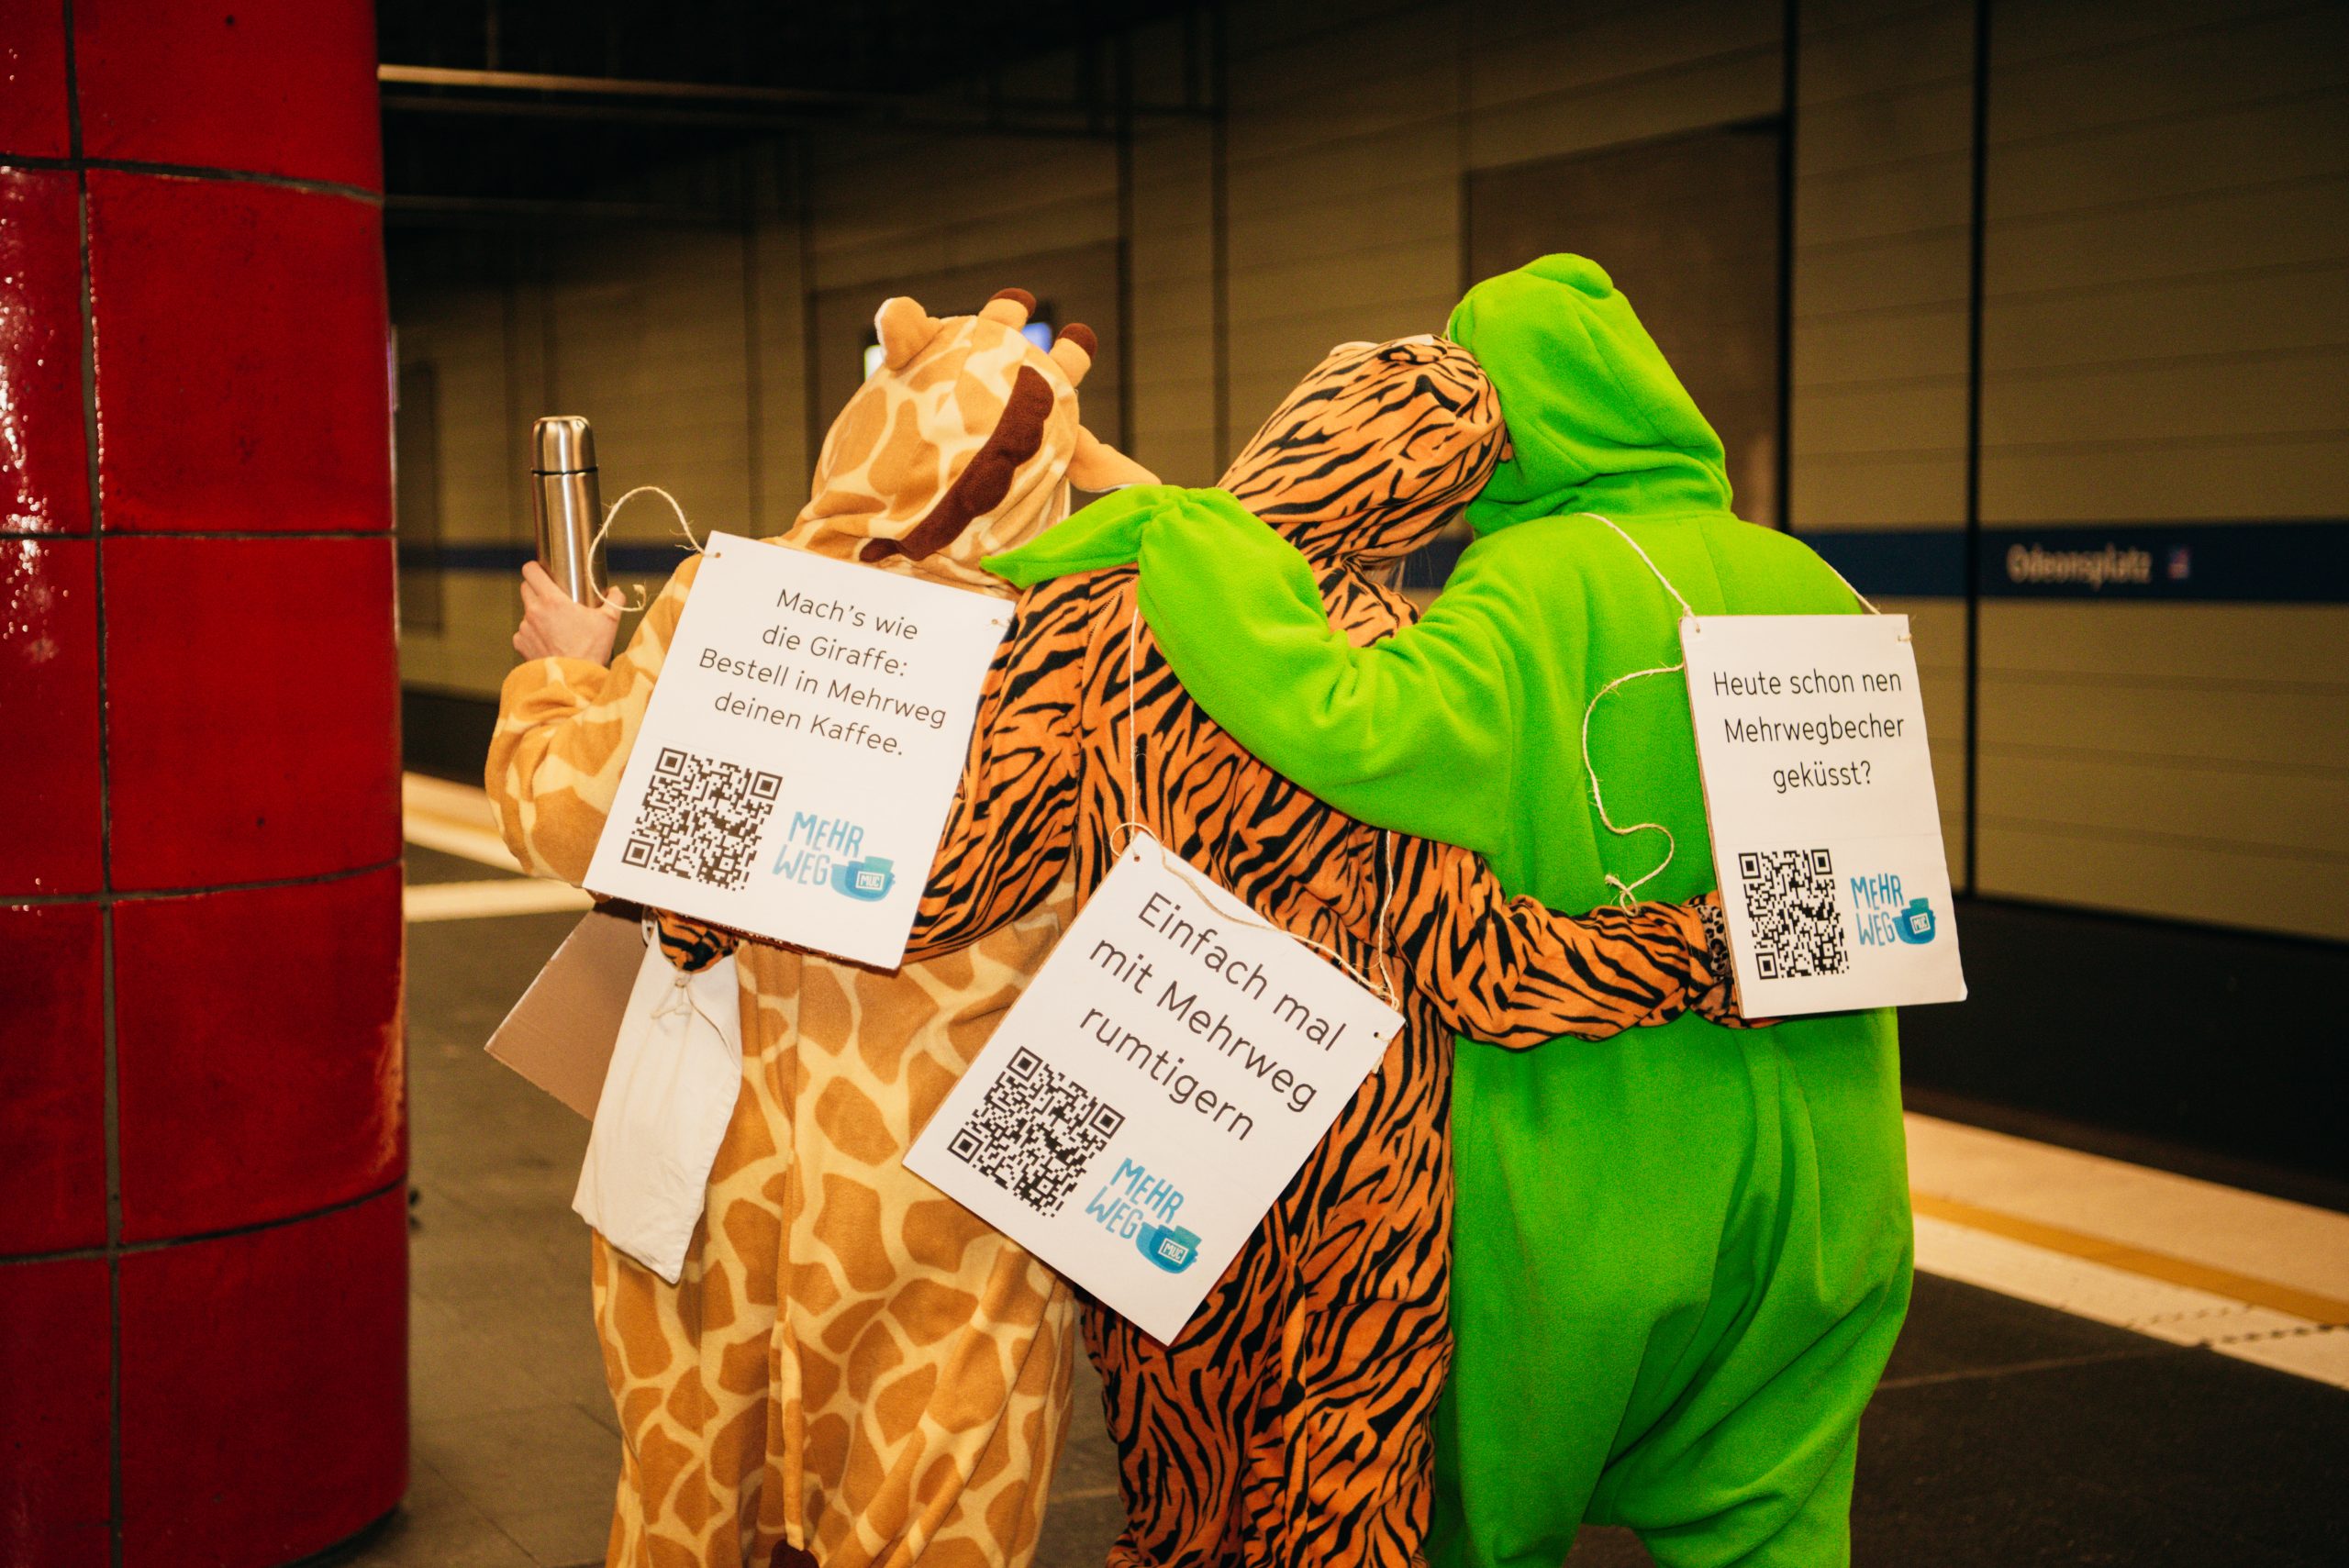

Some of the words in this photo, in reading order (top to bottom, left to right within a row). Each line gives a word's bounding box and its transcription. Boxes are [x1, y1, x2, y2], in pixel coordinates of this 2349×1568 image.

[876, 615, 918, 640] wie
[762, 625, 801, 651] die
[810, 636, 907, 677] Giraffe:
[699, 648, 789, 687] Bestell
[796, 671, 818, 695] in
[827, 679, 947, 729] Mehrweg
[1713, 671, 1782, 696] Heute
[1790, 668, 1854, 695] schon
[1862, 672, 1902, 692] nen
[715, 692, 802, 729] deinen
[810, 714, 903, 756] Kaffee.
[1724, 713, 1905, 745] Mehrwegbecher
[1773, 761, 1872, 794] geküsst?
[787, 811, 864, 858] MEHR
[772, 844, 832, 886] WEG
[860, 873, 882, 887] MUC
[1850, 873, 1905, 910] MEHR
[1855, 911, 1895, 946] WEG
[1137, 891, 1268, 1001] Einfach
[1273, 993, 1347, 1051] mal
[1089, 939, 1153, 995] mit
[1156, 981, 1318, 1114] Mehrweg
[1079, 1007, 1253, 1140] rumtigern
[1109, 1157, 1184, 1224] MEHR
[1085, 1186, 1143, 1240] WEG
[1163, 1242, 1185, 1260] MUC
